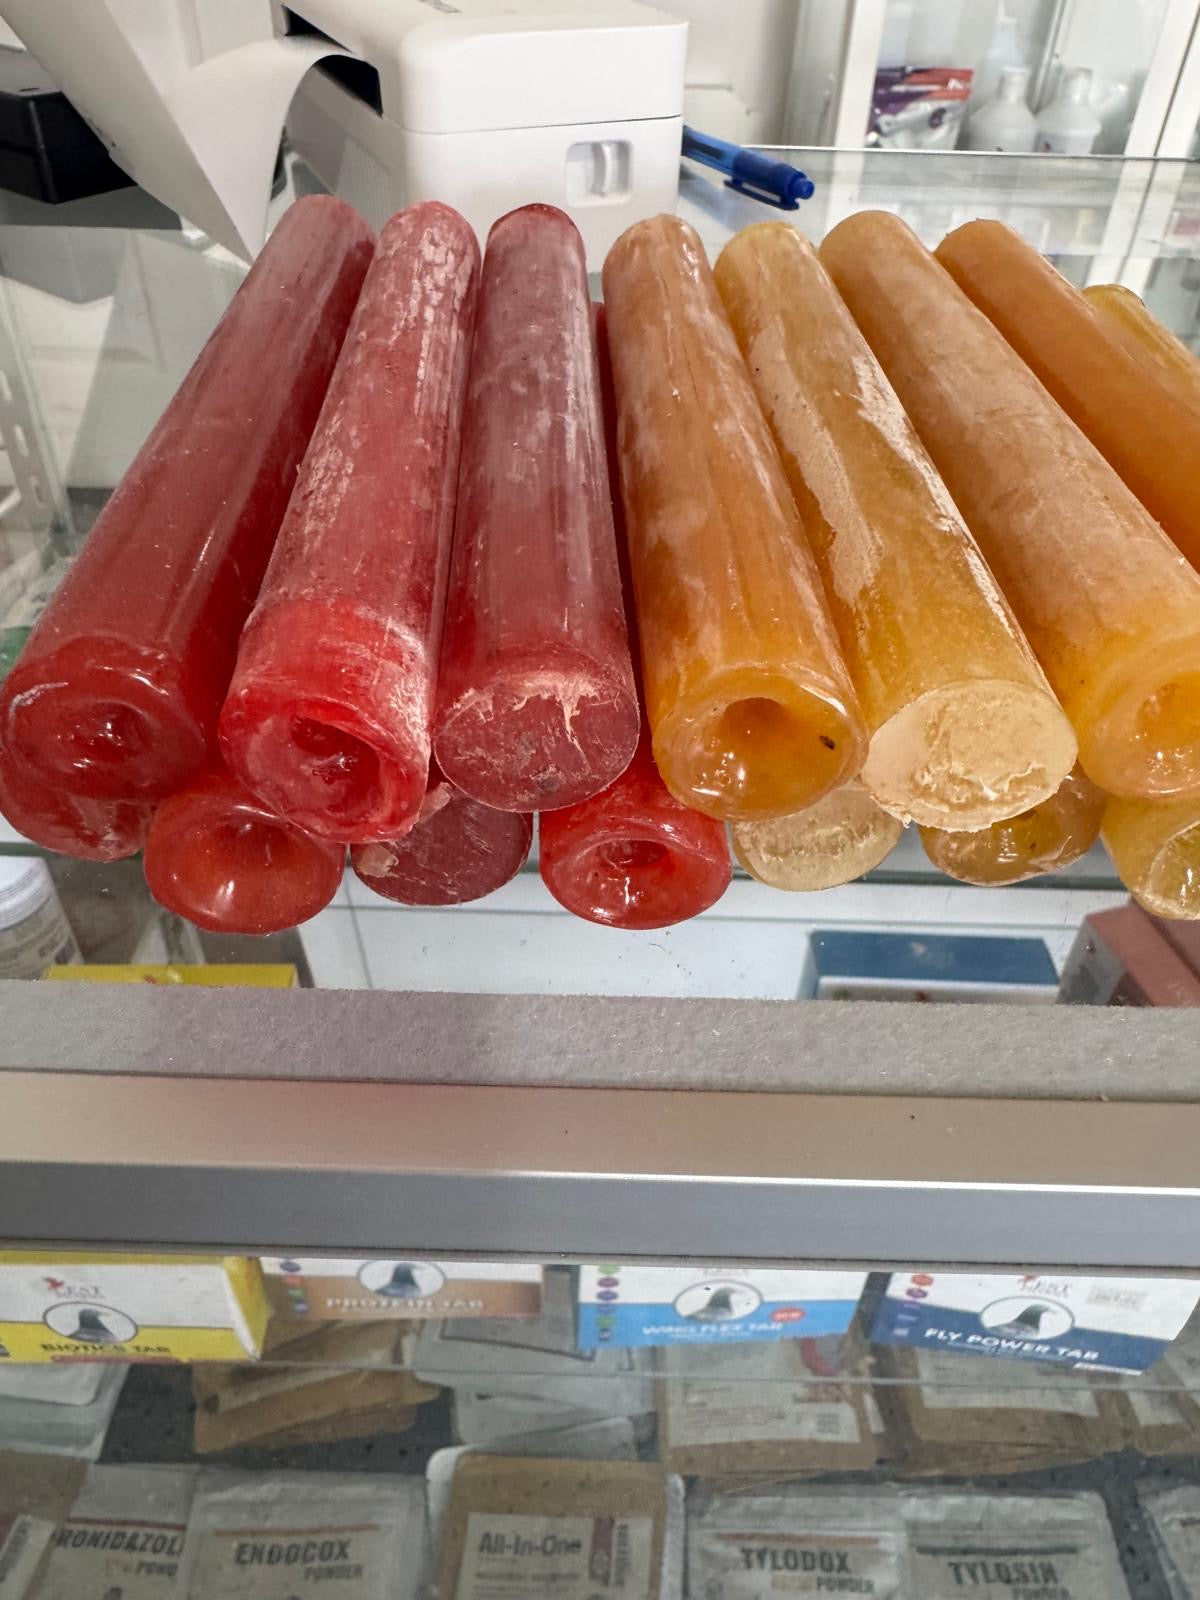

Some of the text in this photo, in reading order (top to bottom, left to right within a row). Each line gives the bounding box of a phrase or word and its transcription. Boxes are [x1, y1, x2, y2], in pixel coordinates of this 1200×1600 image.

[967, 1335, 1052, 1354] POWER
[1056, 1346, 1101, 1361] TAB
[234, 1539, 351, 1566] ENDOCOX
[479, 1531, 582, 1557] All-In-One
[740, 1547, 849, 1573] TYLODOX
[947, 1561, 1059, 1585] TYLOSIN
